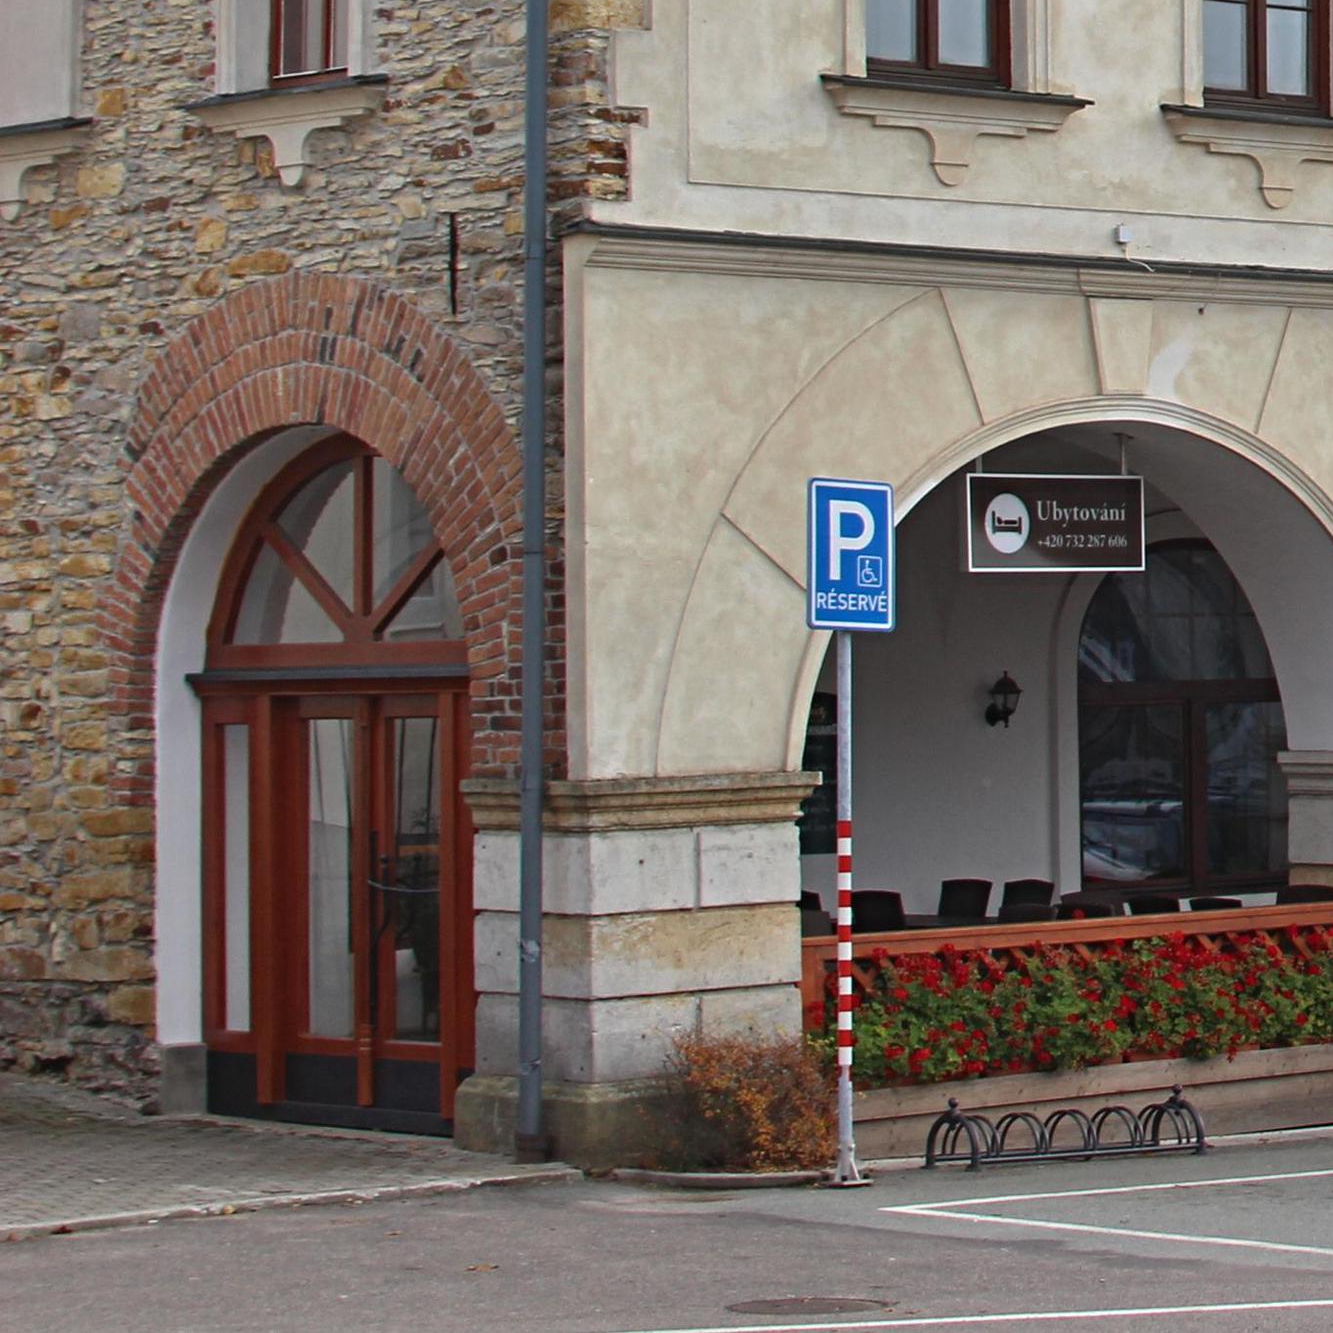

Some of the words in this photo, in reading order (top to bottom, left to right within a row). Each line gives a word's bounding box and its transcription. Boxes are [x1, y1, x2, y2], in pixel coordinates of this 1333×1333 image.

[1036, 500, 1126, 528] Ubytování
[828, 499, 875, 581] P
[1037, 535, 1064, 548] +420
[1066, 535, 1088, 548] 732
[1088, 535, 1105, 548] 287
[1107, 535, 1128, 548] 606
[817, 588, 889, 612] RÉSERVÉ
